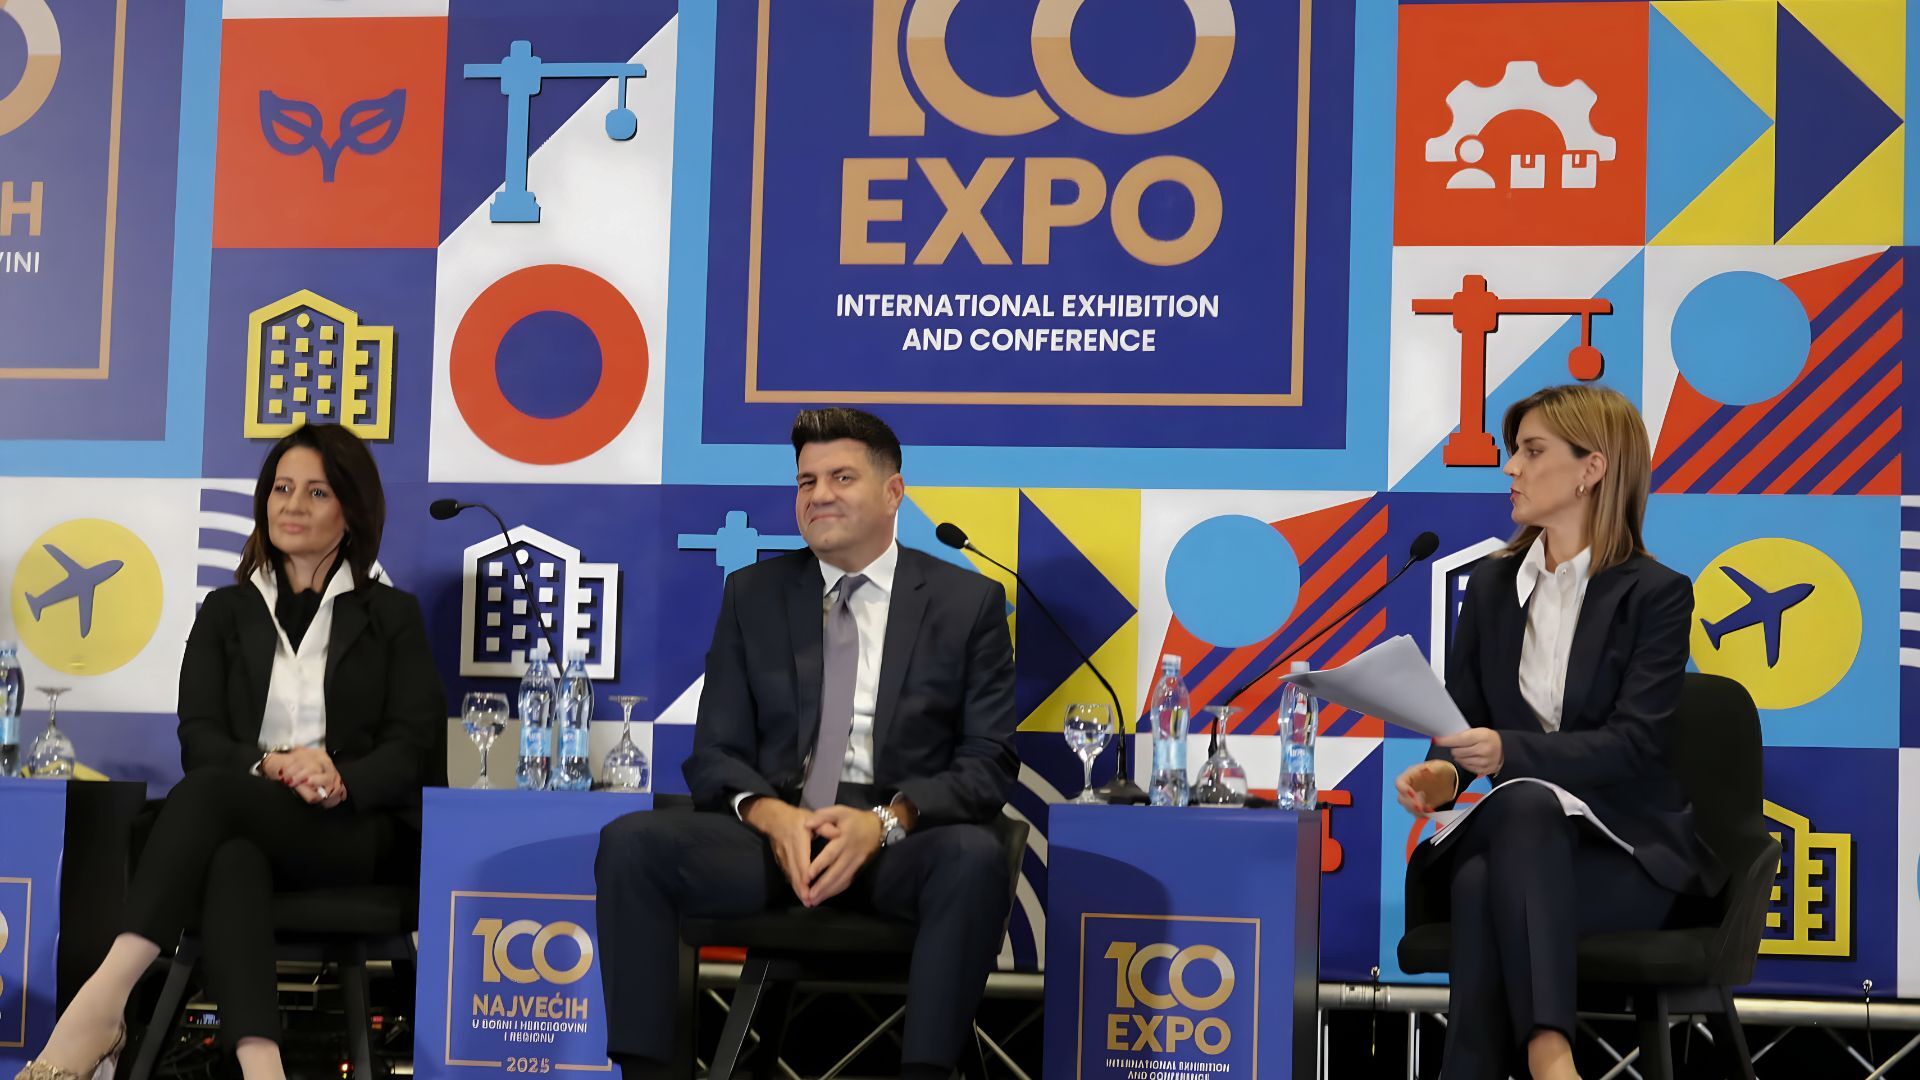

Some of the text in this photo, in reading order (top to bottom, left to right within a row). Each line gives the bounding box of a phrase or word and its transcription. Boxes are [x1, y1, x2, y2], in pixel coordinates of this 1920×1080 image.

[839, 155, 1223, 266] EXPO
[836, 293, 1219, 318] INTERNATIONAL EXHIBITION
[901, 327, 1156, 352] AND CONFERENCE
[472, 918, 594, 985] 100
[1104, 941, 1235, 1011] 100
[472, 992, 588, 1020] NAJVEĆIH
[1106, 1013, 1231, 1055] EXPO
[506, 1056, 550, 1073] 2025
